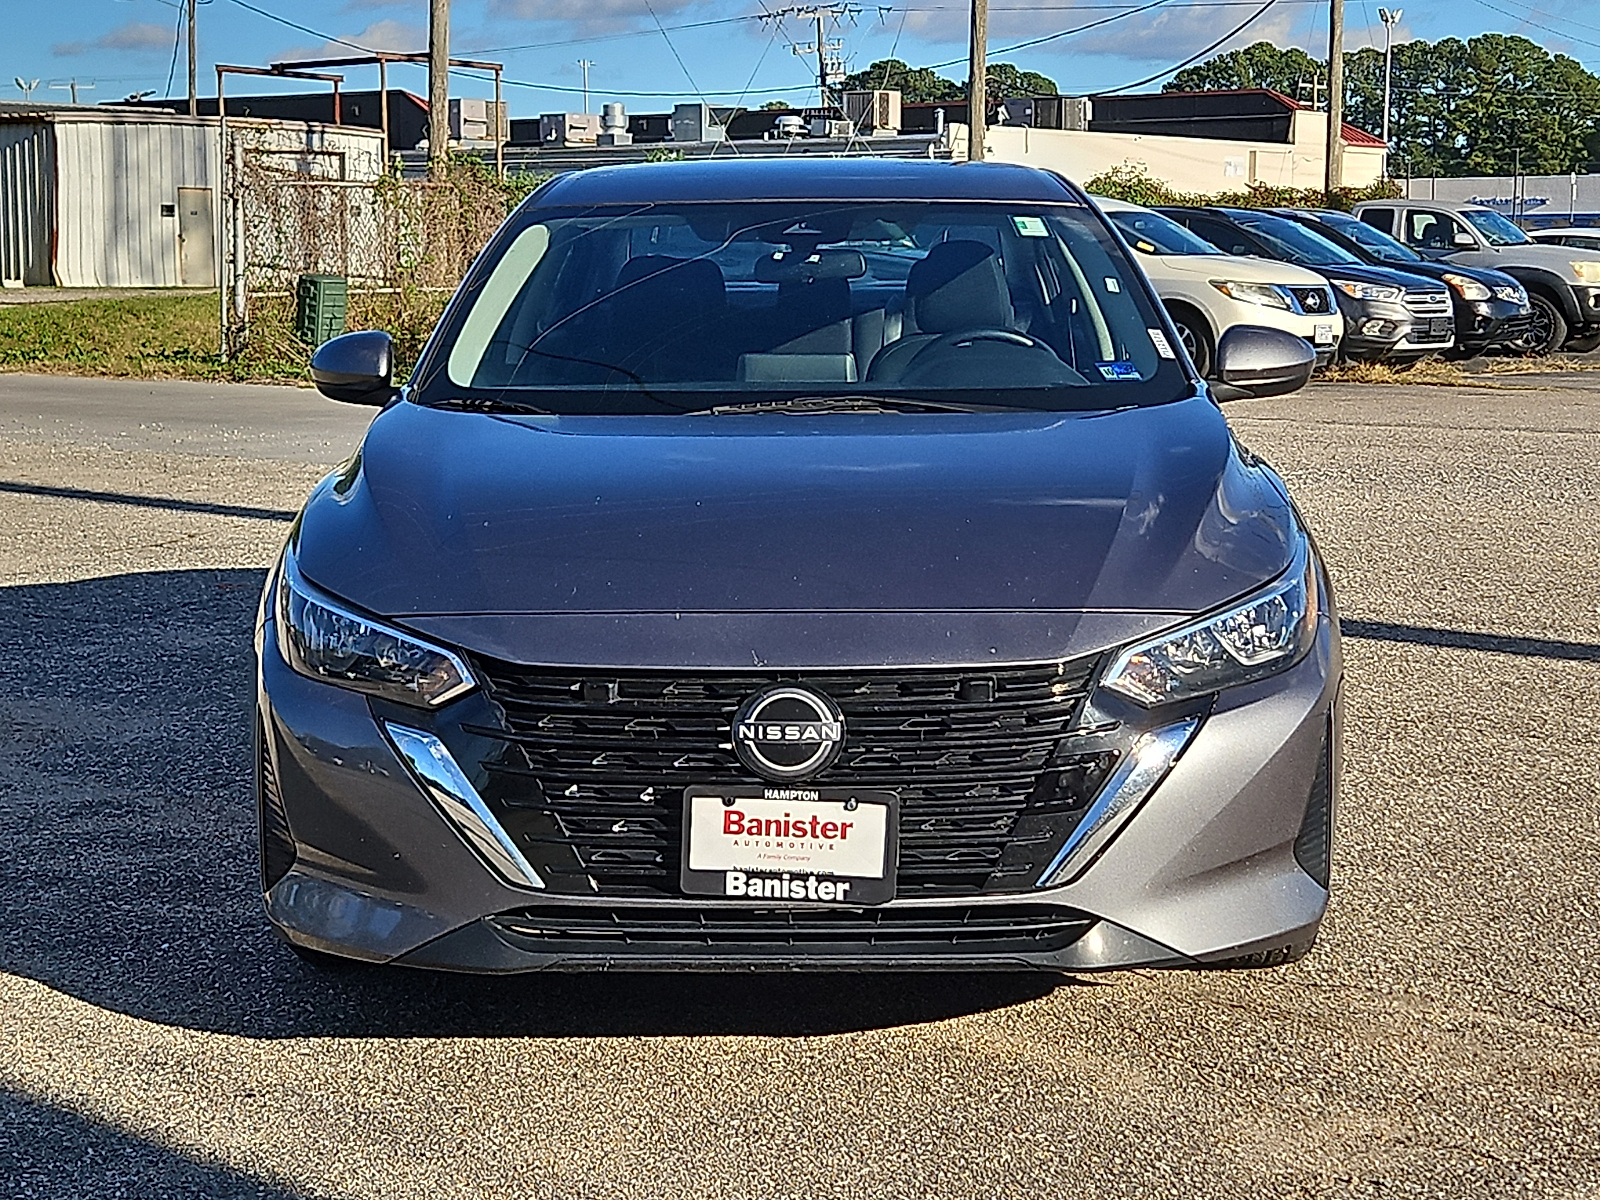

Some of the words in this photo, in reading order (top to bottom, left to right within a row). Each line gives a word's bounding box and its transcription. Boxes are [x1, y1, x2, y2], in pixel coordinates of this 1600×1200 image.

[739, 725, 838, 740] NISSAN
[764, 789, 819, 801] HAMPTON
[723, 810, 854, 839] Banister
[733, 840, 835, 850] AUTOMOTIVE
[783, 854, 811, 862] Company
[726, 871, 850, 900] Banister
